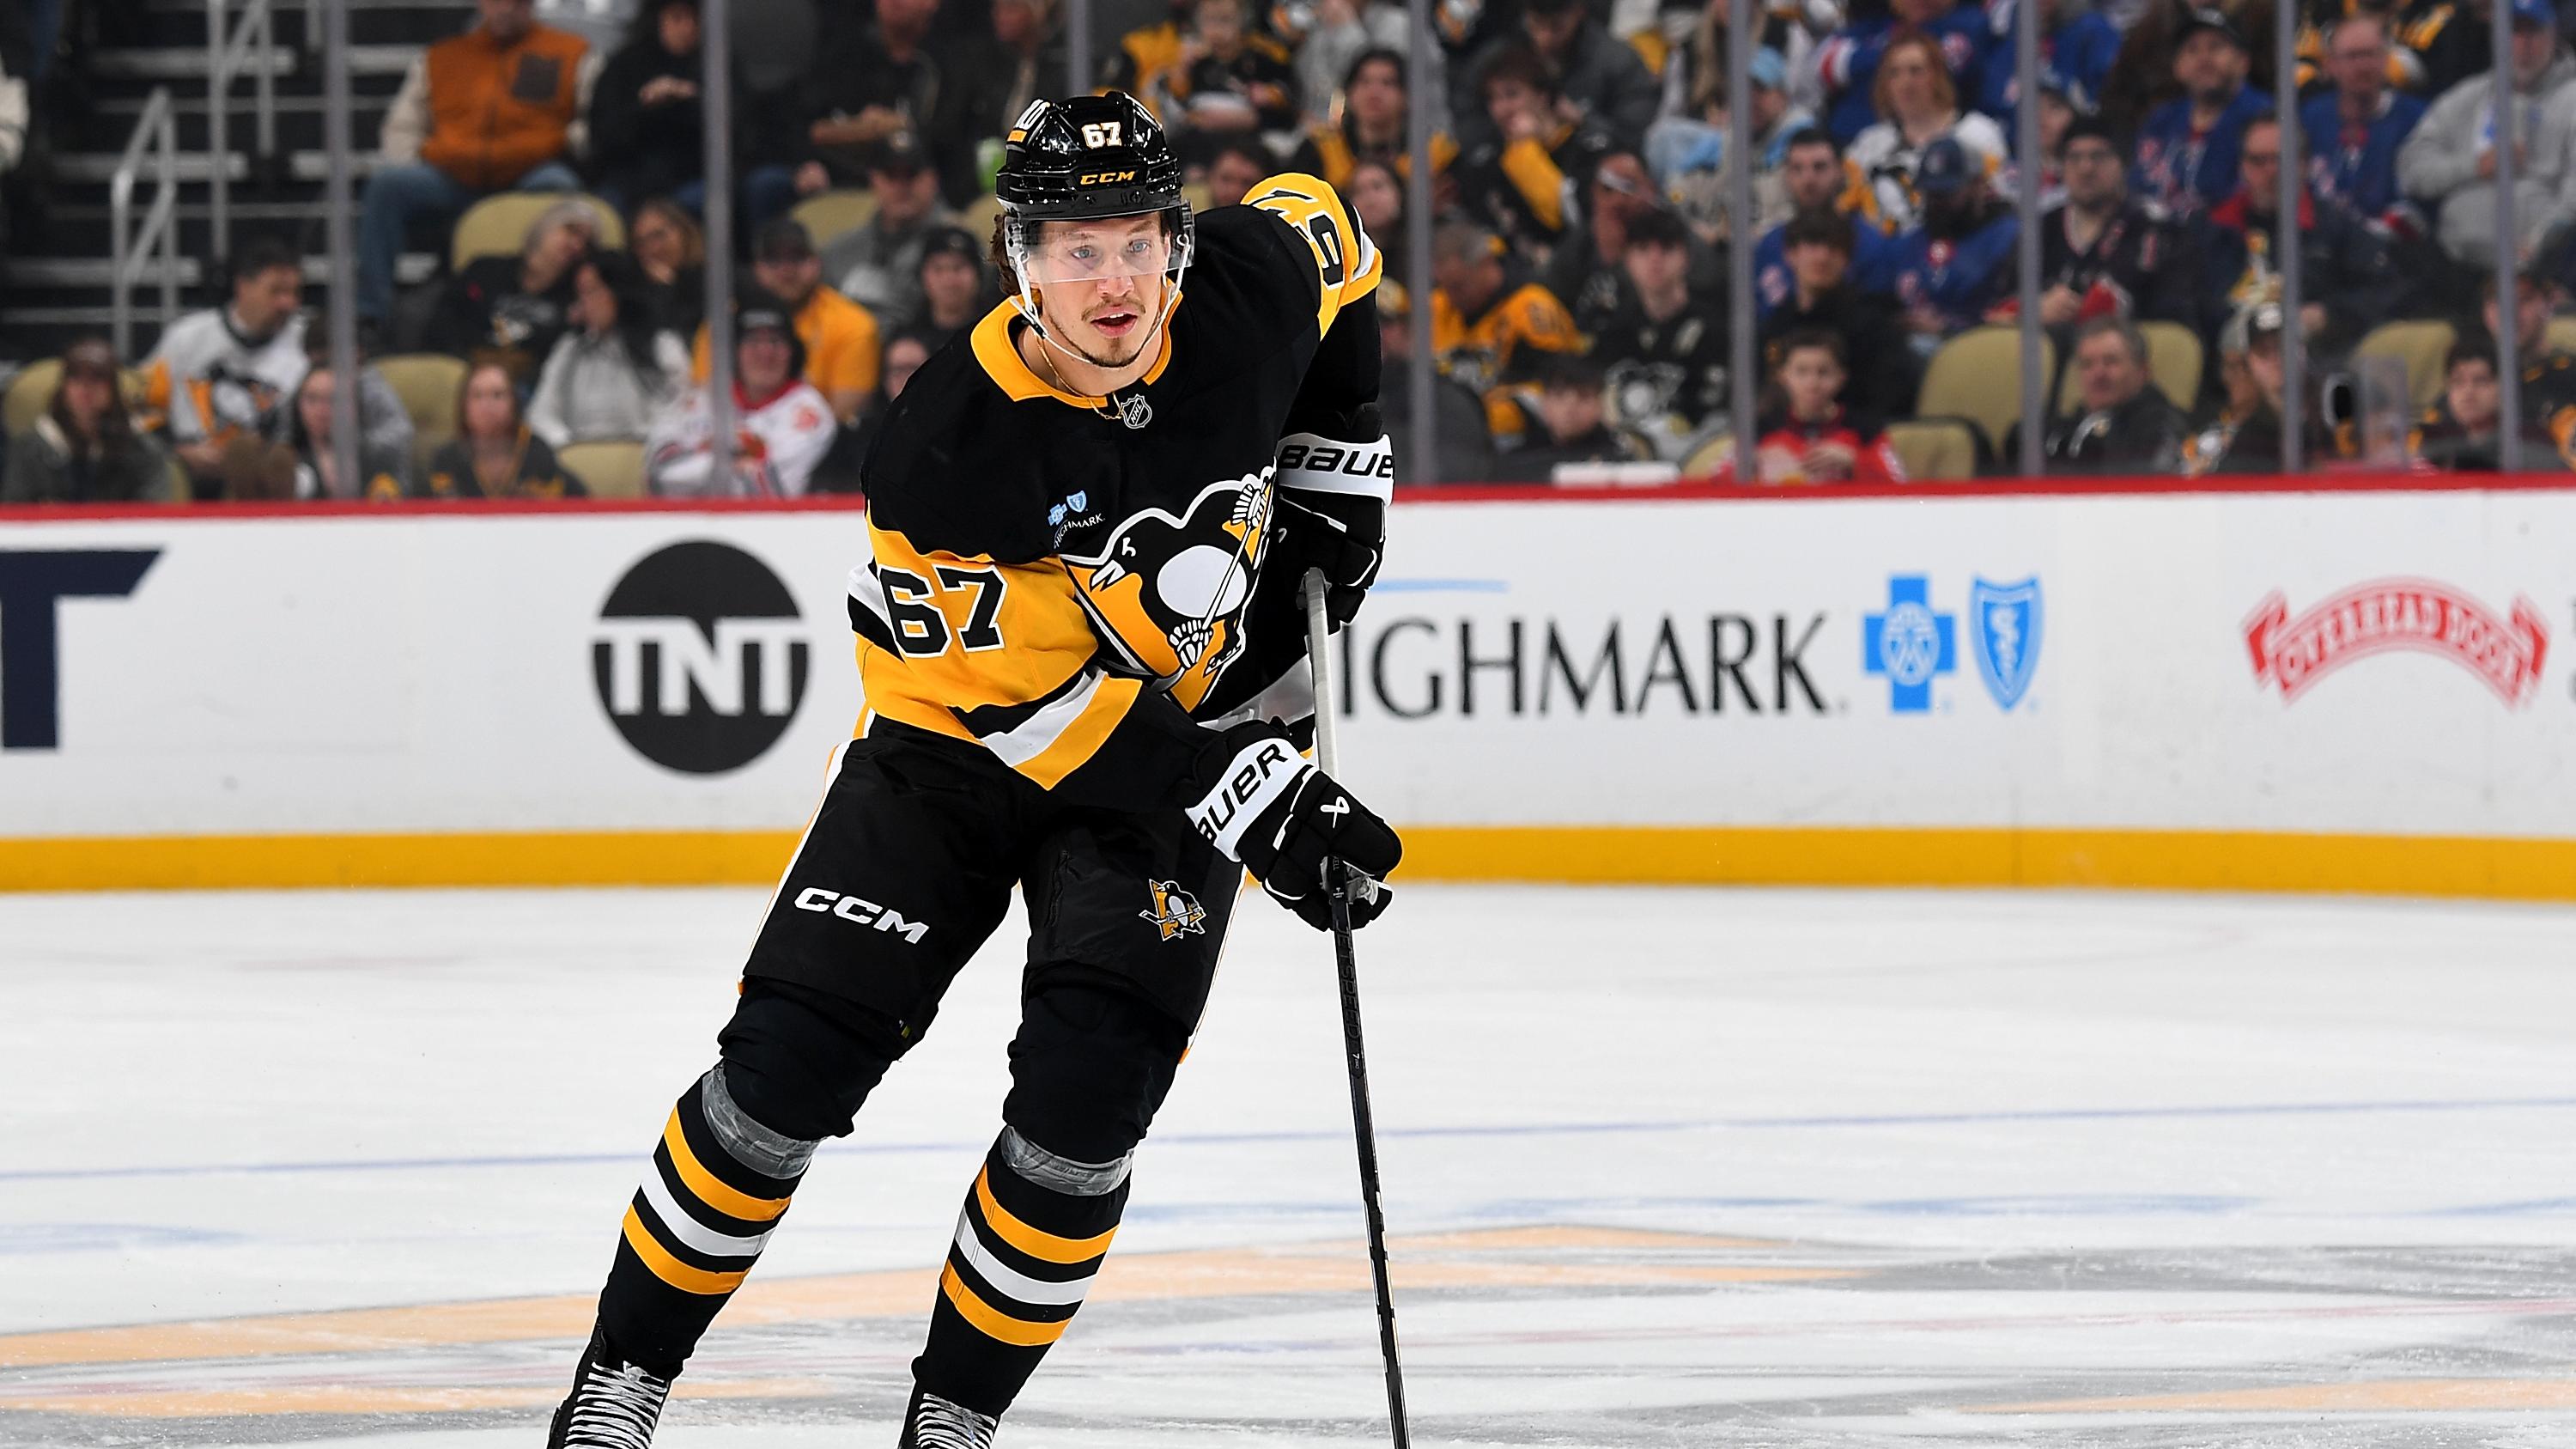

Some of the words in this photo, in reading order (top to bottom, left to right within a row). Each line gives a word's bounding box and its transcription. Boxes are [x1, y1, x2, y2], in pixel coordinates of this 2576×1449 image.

[1081, 121, 1122, 149] 67
[1079, 171, 1136, 186] CCM
[1278, 444, 1393, 478] BAUE
[877, 563, 1009, 659] 67
[592, 615, 809, 716] TNT
[1338, 612, 1829, 720] IGHMARK
[1197, 743, 1288, 840] AUER
[794, 887, 929, 944] CCM
